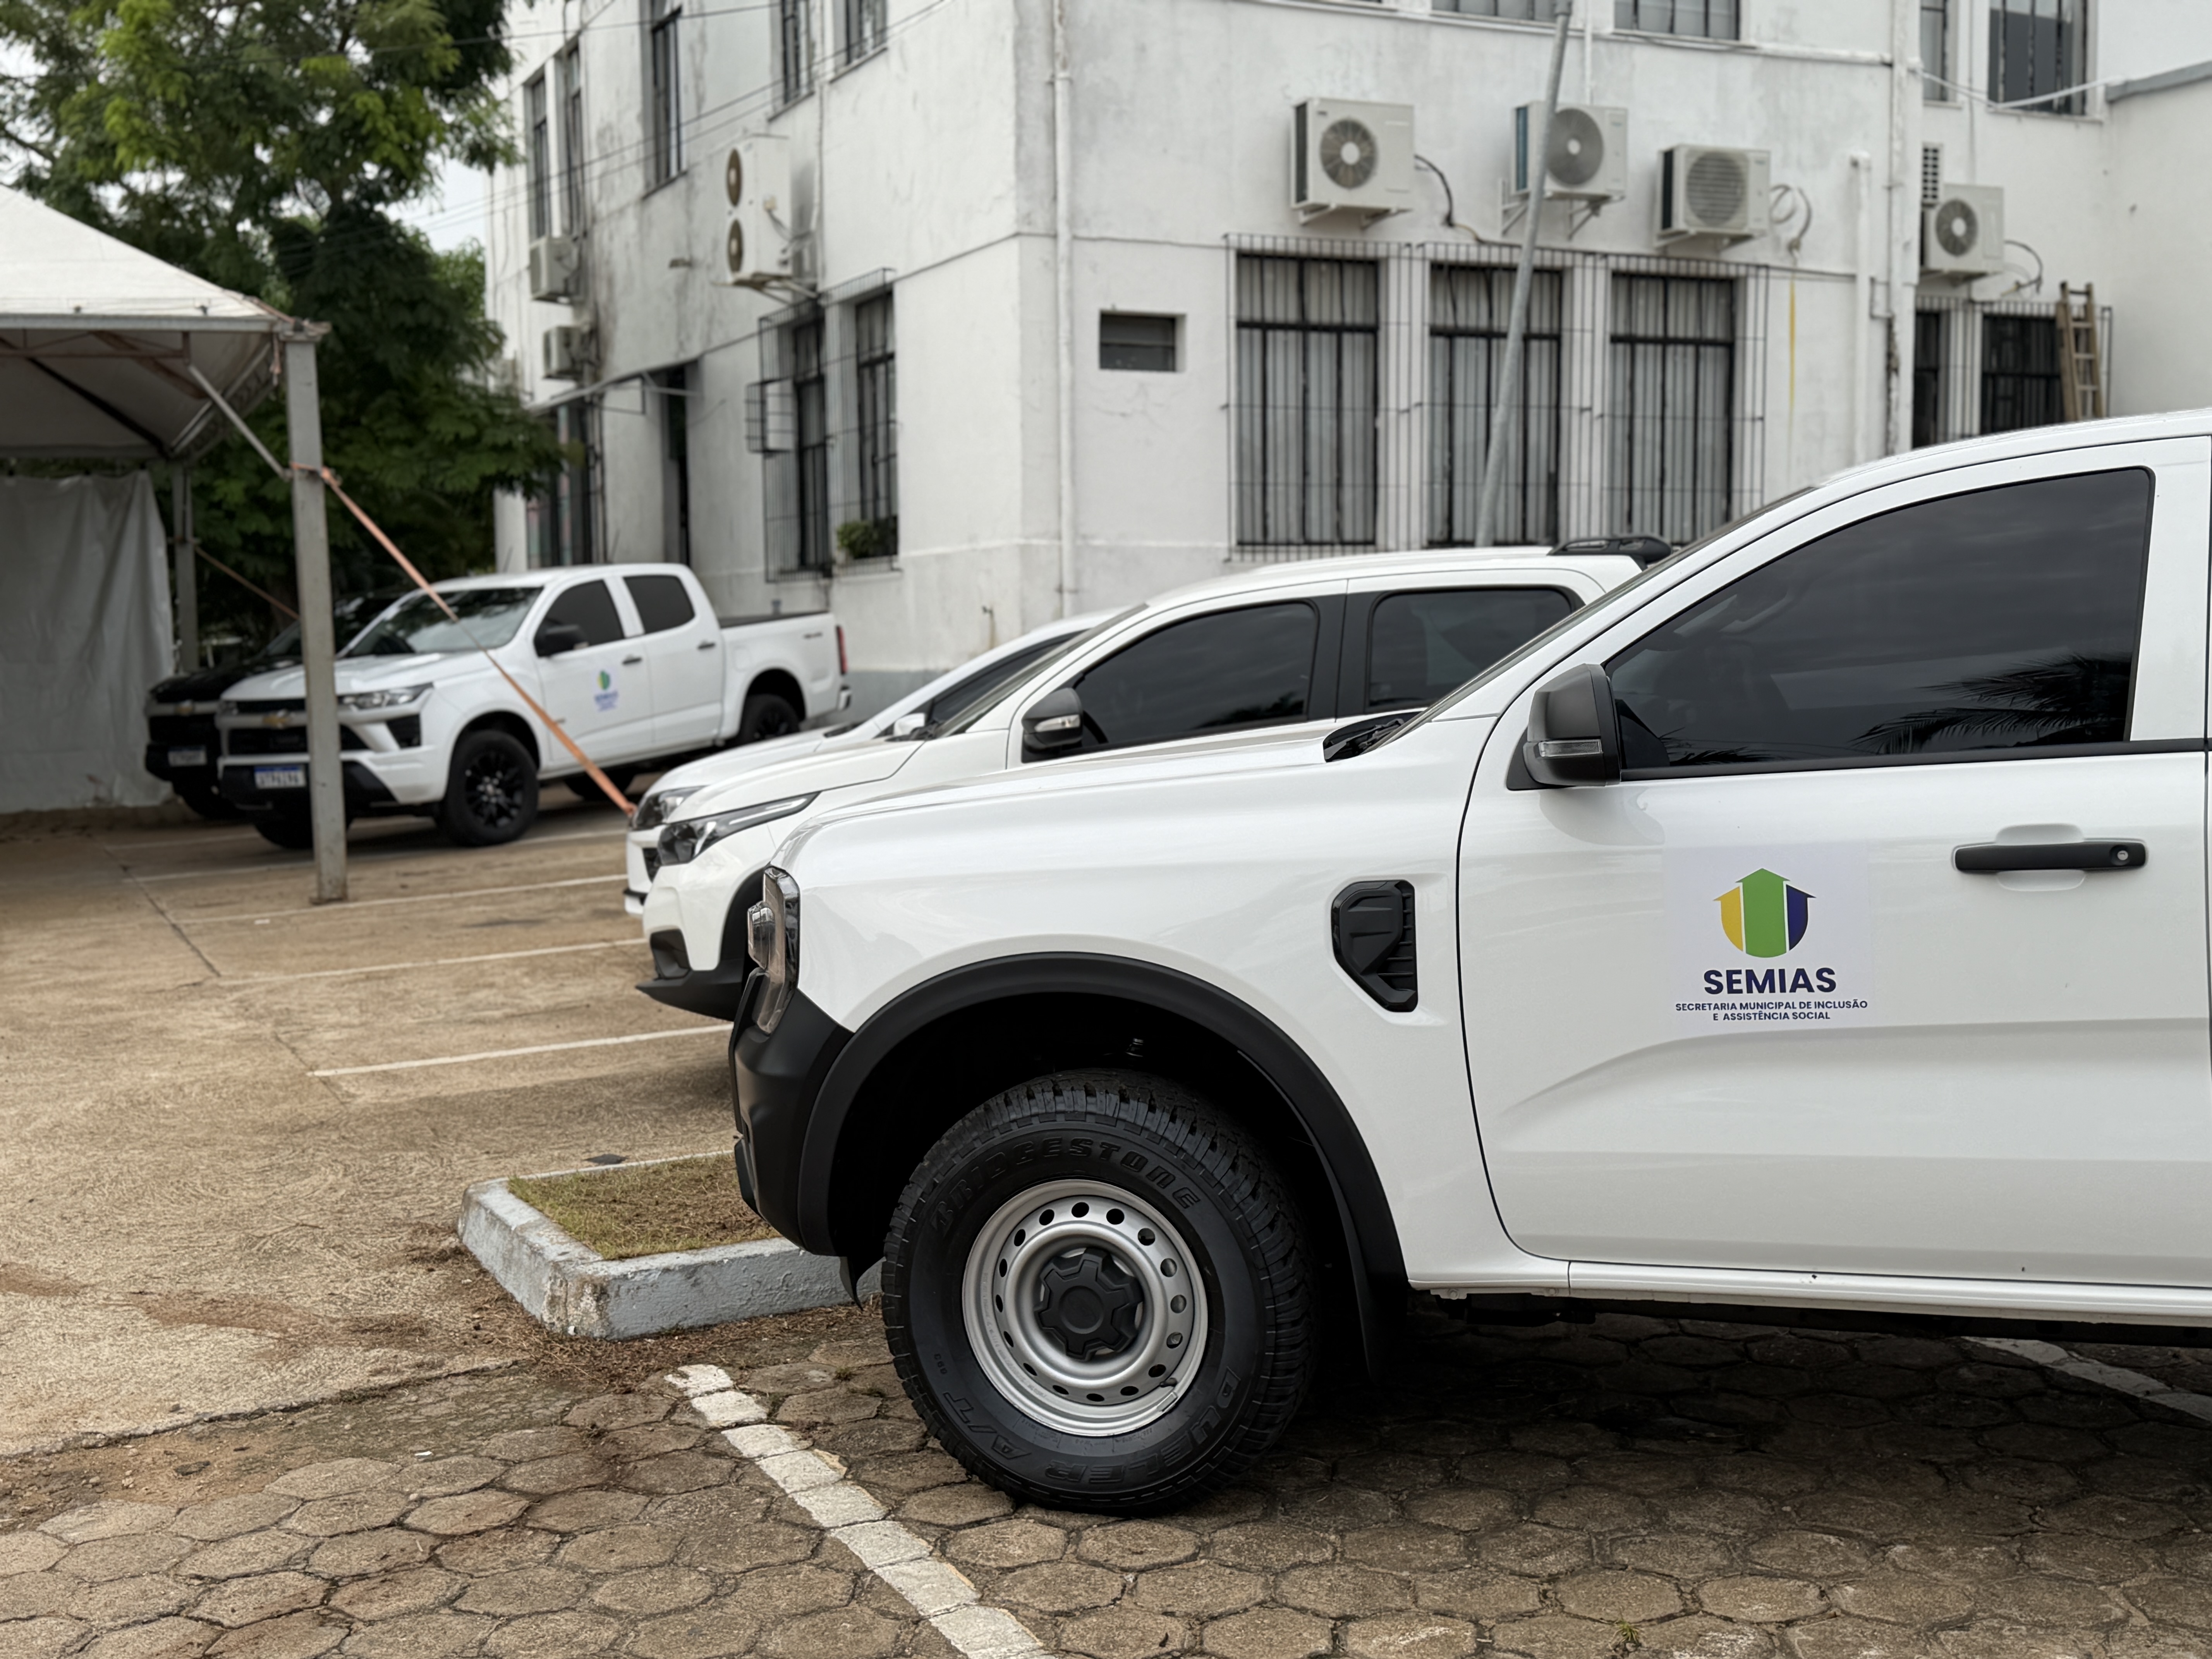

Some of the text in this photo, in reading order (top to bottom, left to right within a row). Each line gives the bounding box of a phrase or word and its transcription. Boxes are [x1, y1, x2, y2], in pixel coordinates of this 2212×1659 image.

[1704, 967, 1836, 995] SEMIAS
[1675, 999, 1868, 1011] SECRETARIA MUNICIPAL DE INCLUSÃO
[1723, 1010, 1790, 1020] ASSISTÊNCIA
[1792, 1012, 1831, 1020] SOCIAL
[933, 1137, 1201, 1233] BRIDGESTONE
[944, 1392, 1032, 1459] A/T
[1046, 1366, 1241, 1484] DUELER
